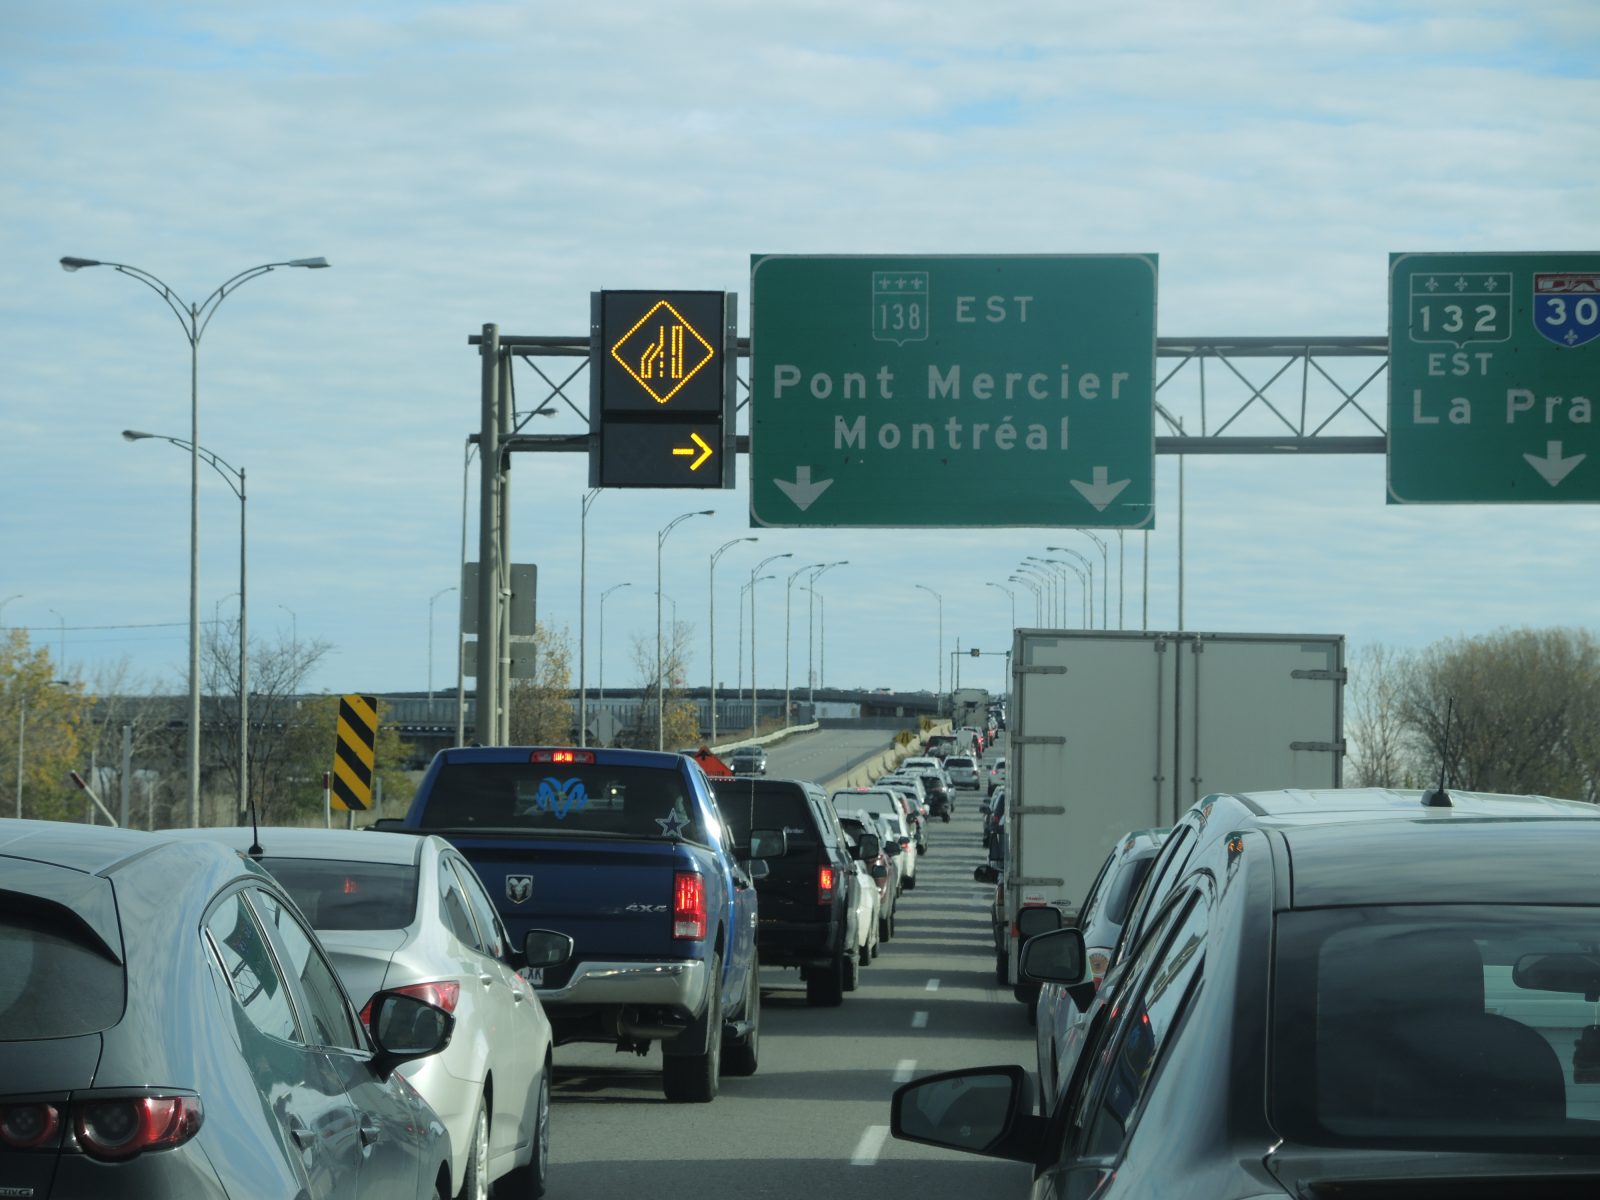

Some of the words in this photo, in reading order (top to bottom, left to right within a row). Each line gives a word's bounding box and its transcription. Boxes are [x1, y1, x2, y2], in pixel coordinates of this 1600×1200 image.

[880, 303, 921, 330] 138
[955, 296, 1034, 322] EST
[1419, 304, 1497, 332] 132
[1545, 298, 1598, 326] 30
[1428, 352, 1493, 376] EST
[774, 364, 895, 399] Pont
[928, 364, 1130, 400] Mercier
[1413, 389, 1471, 424] La
[1506, 388, 1592, 424] Pra
[834, 415, 1069, 450] Montréal
